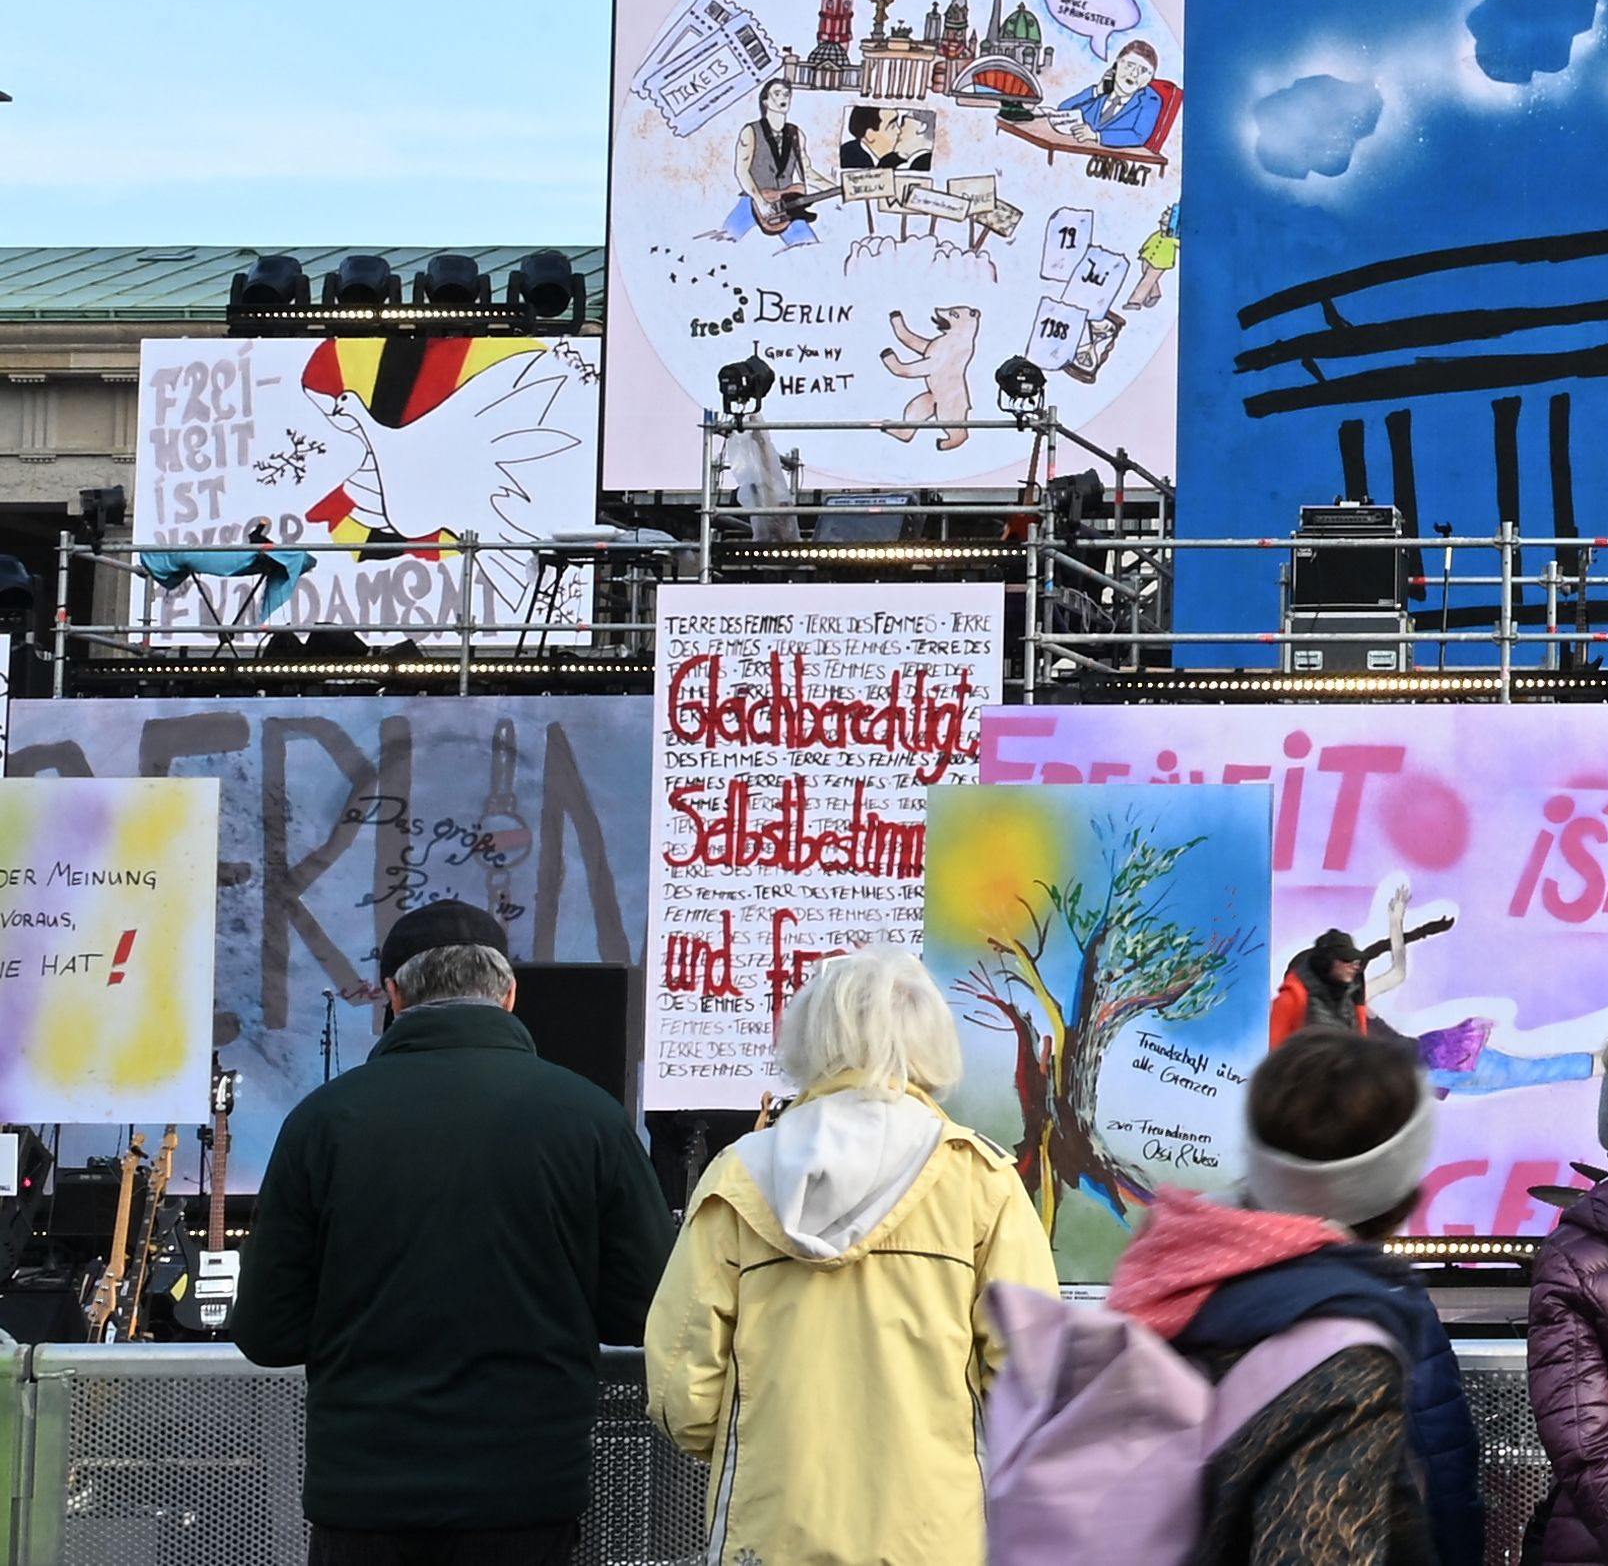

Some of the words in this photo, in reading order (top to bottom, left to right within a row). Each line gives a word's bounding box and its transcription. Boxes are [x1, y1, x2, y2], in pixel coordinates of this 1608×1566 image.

[665, 59, 728, 104] TICKETS
[1086, 155, 1152, 187] CONTRACT
[1058, 226, 1078, 249] 19
[754, 288, 853, 324] BERLIN
[779, 374, 854, 396] HEART
[664, 614, 718, 635] TERRE
[910, 638, 960, 656] TERRE
[963, 638, 991, 655] DES
[665, 752, 698, 768] DES
[700, 752, 778, 768] FEMMES
[789, 752, 831, 767] TERRE
[47, 861, 157, 890] MEINUNG
[664, 885, 692, 900] DES
[832, 885, 896, 899] FEMMES
